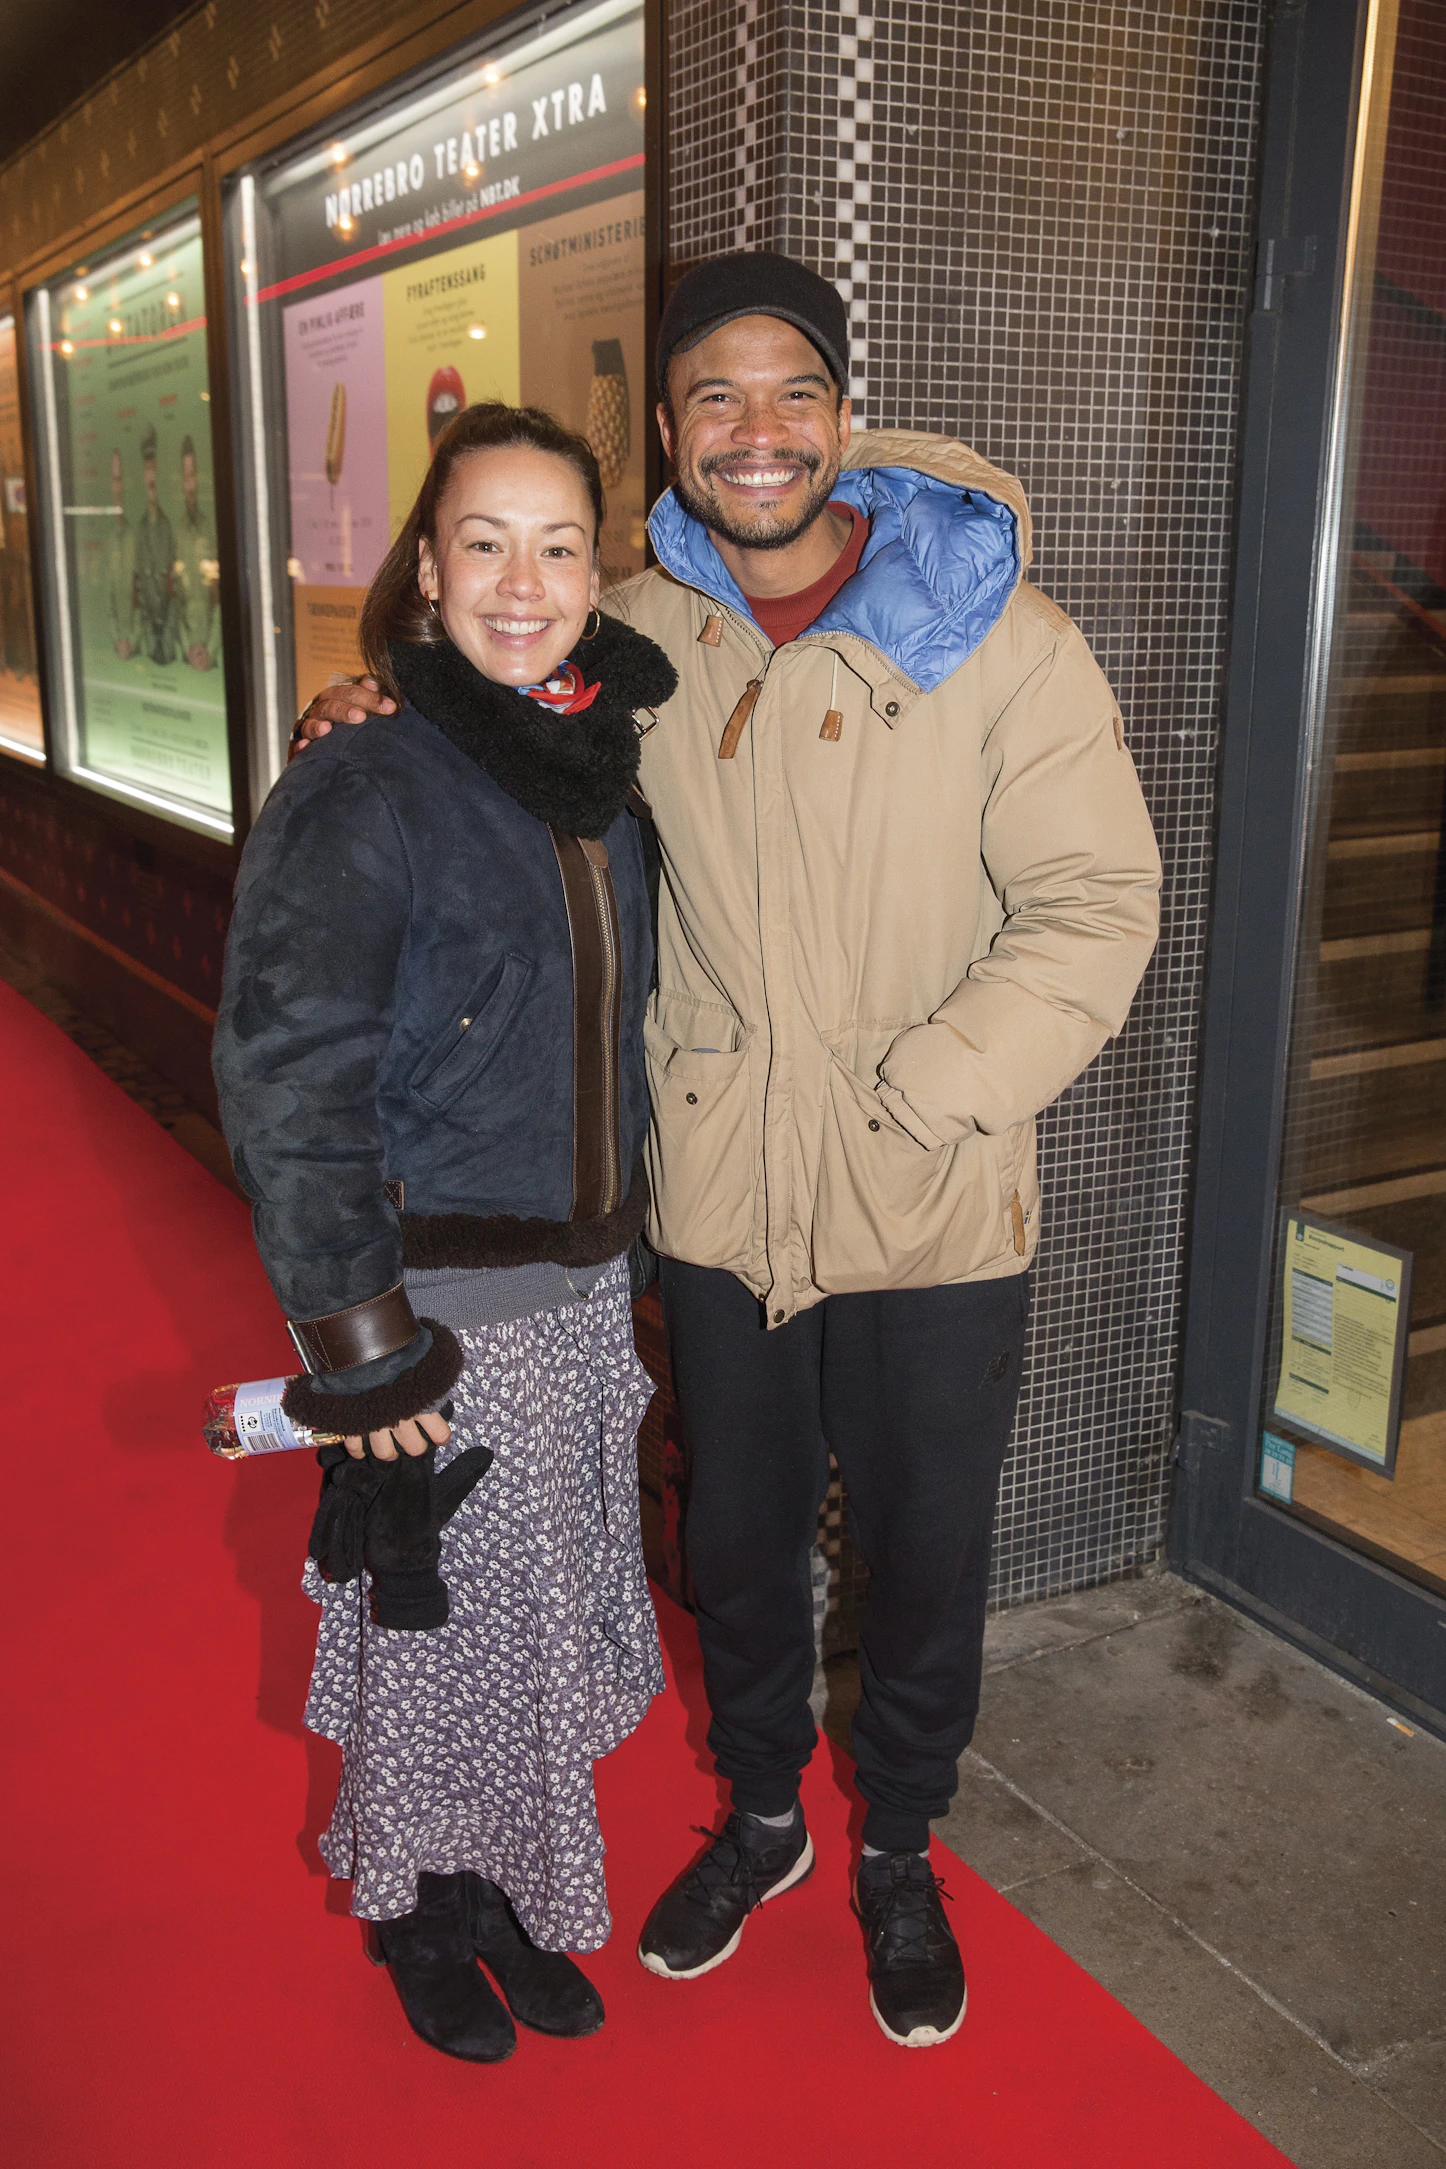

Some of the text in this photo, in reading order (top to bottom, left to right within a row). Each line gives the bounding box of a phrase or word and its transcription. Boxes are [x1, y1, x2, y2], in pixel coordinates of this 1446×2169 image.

[325, 73, 607, 228] NØRREBRO TEATER XTRA
[406, 263, 487, 303] FYRAFTENSSANG
